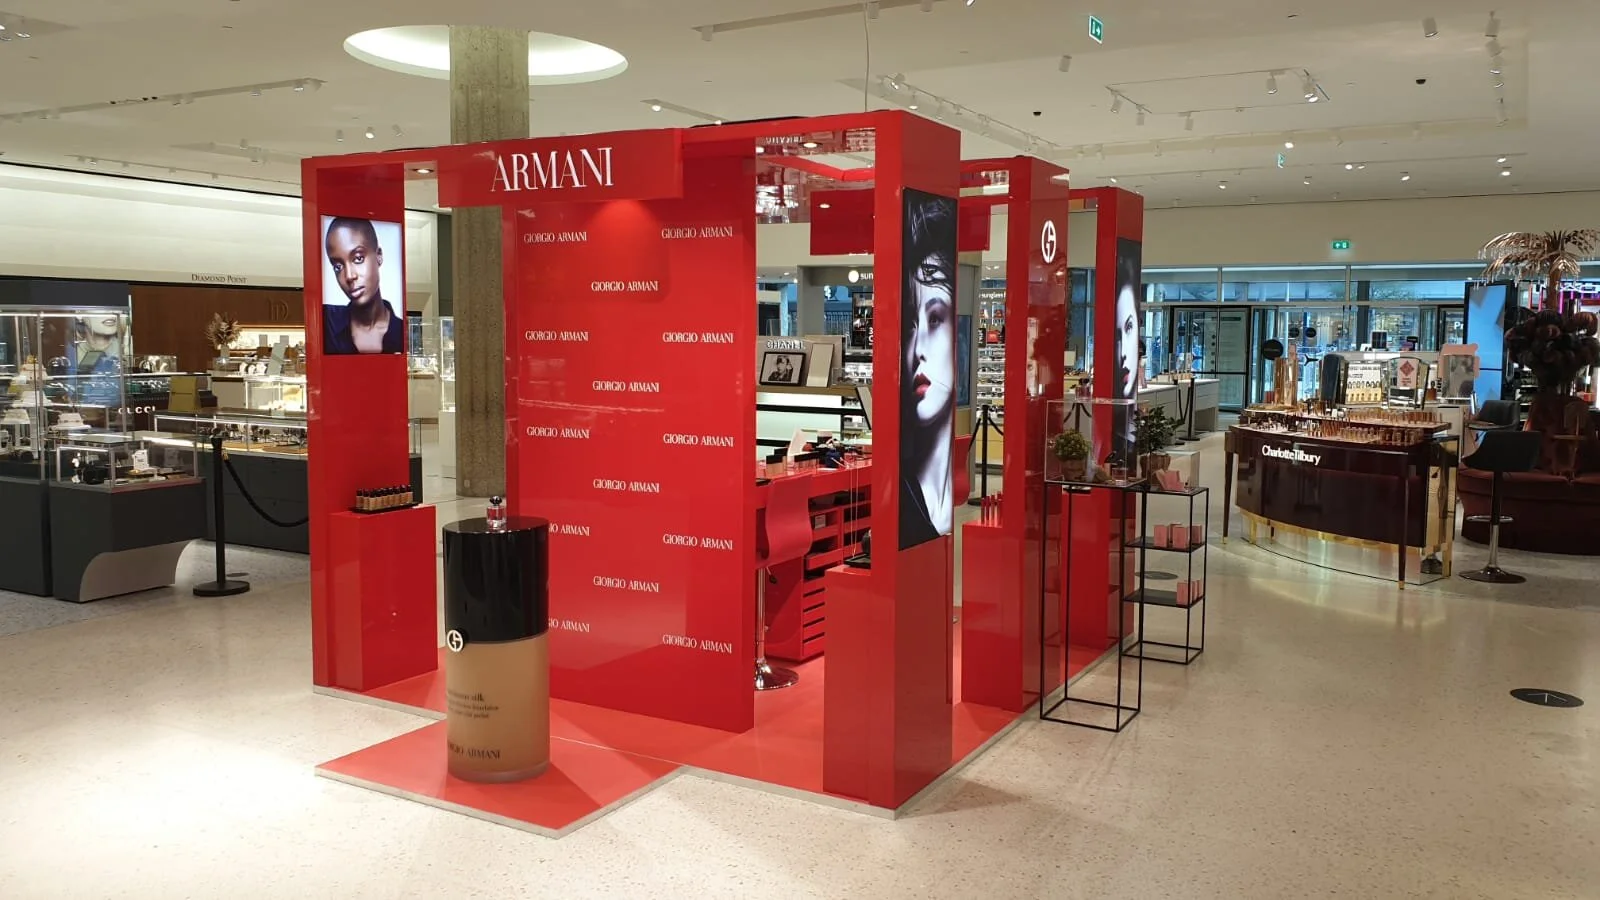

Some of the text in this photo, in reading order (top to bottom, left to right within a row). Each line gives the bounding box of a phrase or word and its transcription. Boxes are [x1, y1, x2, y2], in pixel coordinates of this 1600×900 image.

[491, 147, 614, 192] ARMANI
[523, 231, 587, 244] GIORGIO ARMANI
[661, 225, 733, 239] GIORGIO ARMANI
[591, 280, 659, 292] GIORGIO ARMANI
[525, 330, 589, 342] GIORGIO ARMANI
[662, 331, 734, 344] GIORGIO ARMANI
[592, 380, 660, 393] GIORGIO ARMANI
[526, 426, 590, 439] GIORGIO ARMANI
[663, 433, 734, 448] GIORGIO ARMANI
[593, 478, 660, 493] GIORGIO ARMANI
[560, 523, 590, 537] ARMANI
[662, 533, 733, 550] GIORGIO ARMANI
[593, 575, 660, 593] GIORGIO ARMANI
[561, 619, 590, 633] ARMANI
[662, 634, 732, 654] GIORGIO ARMANI
